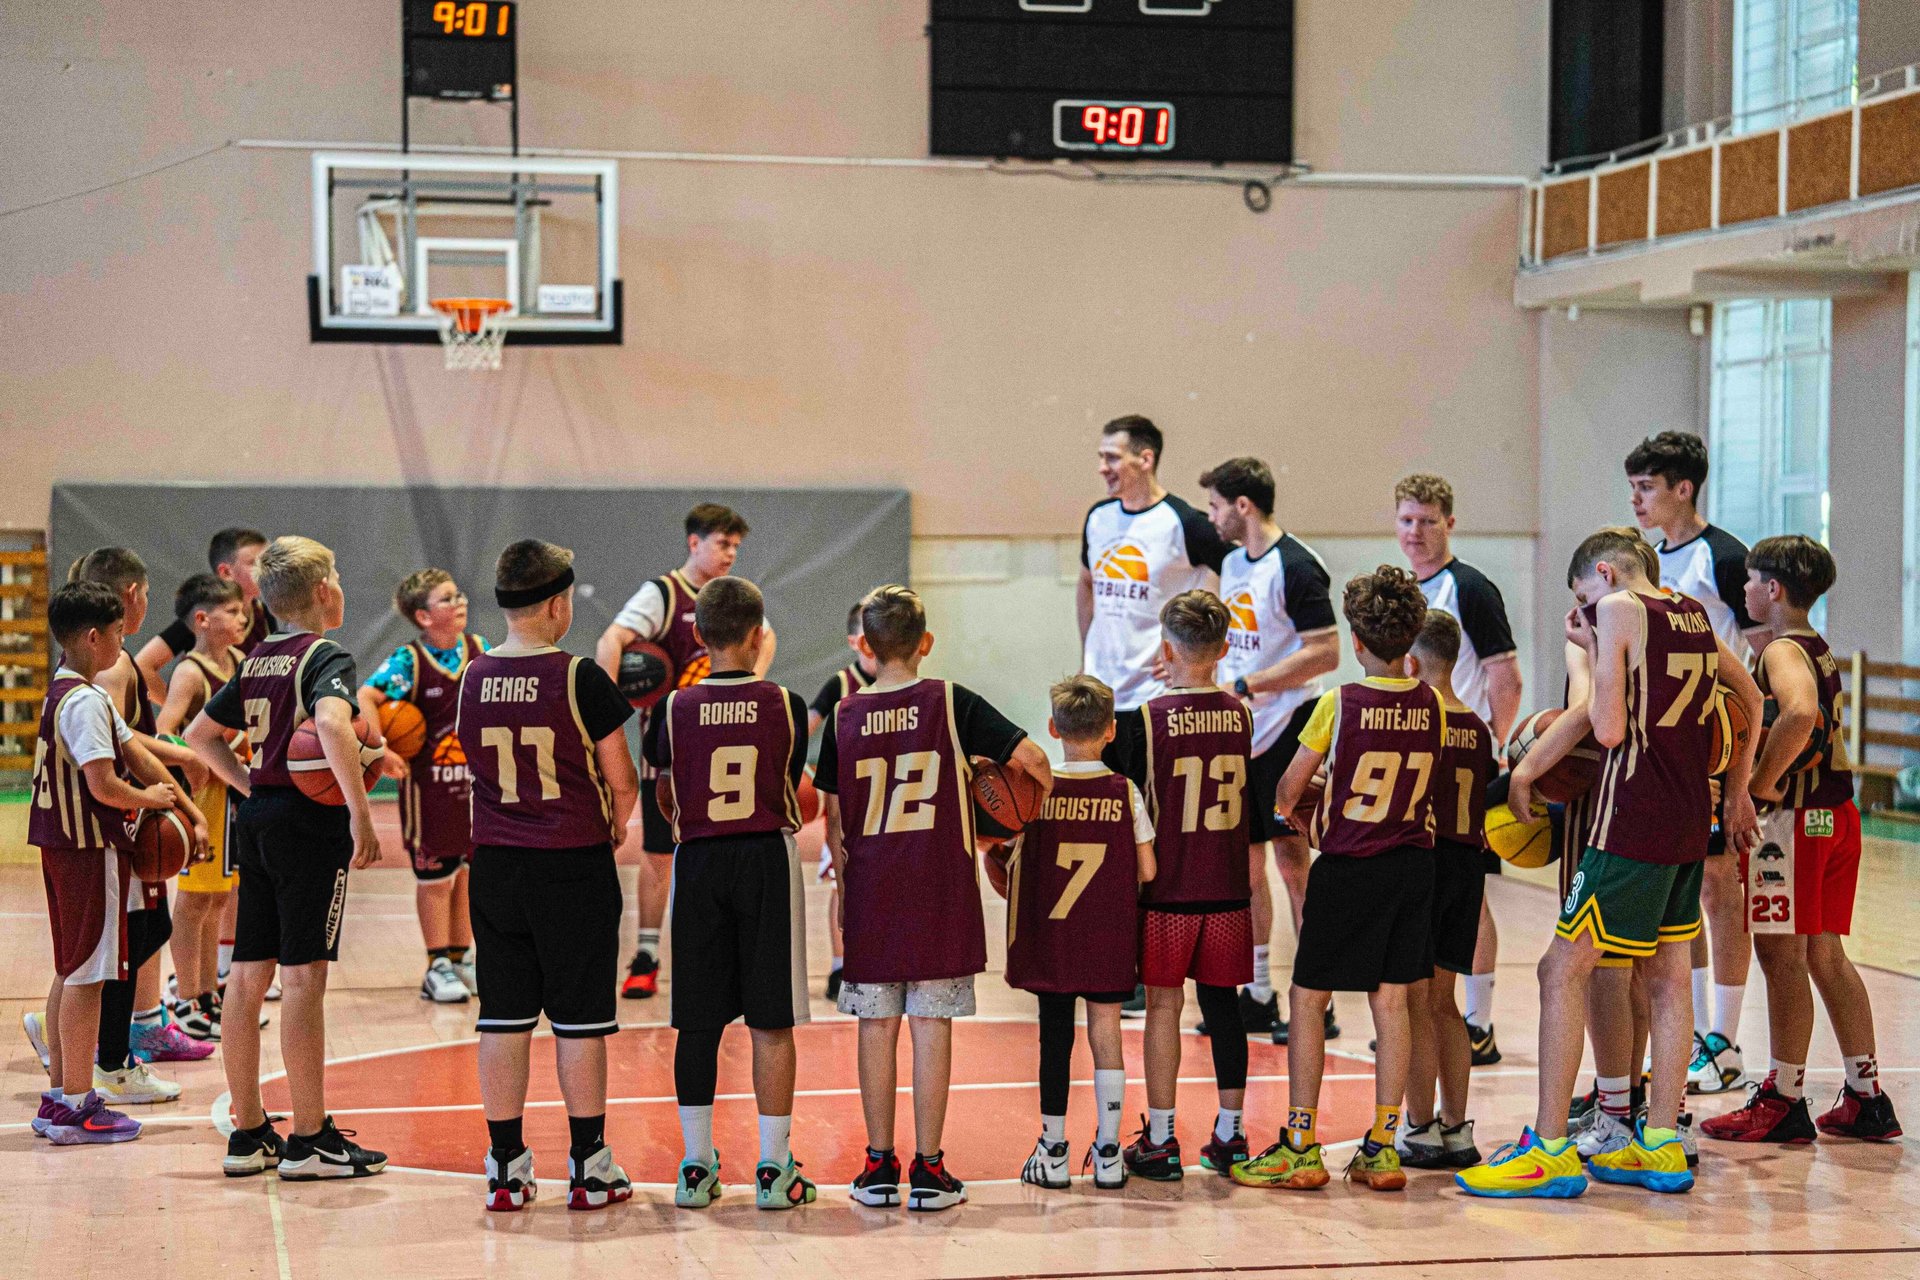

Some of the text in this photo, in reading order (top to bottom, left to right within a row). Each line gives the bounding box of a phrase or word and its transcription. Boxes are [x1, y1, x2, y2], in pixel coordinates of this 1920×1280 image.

[433, 1, 509, 36] 9:01
[1082, 106, 1169, 146] 9:01
[480, 676, 540, 703] BENAS
[699, 701, 758, 726] ROKAS
[861, 706, 919, 736] JONAS
[1167, 706, 1243, 737] ŠIŠKINAS
[1360, 703, 1430, 731] MATĖJUS
[1446, 726, 1477, 750] GNAS
[481, 726, 562, 803] 11
[707, 745, 759, 822] 9
[856, 750, 941, 836] 12
[1173, 754, 1247, 833] 13
[1455, 767, 1474, 834] 1
[1048, 842, 1107, 919] 7
[1565, 871, 1585, 914] 3
[1752, 894, 1790, 922] 23
[1288, 1111, 1312, 1130] 23
[1384, 1113, 1398, 1131] 2
